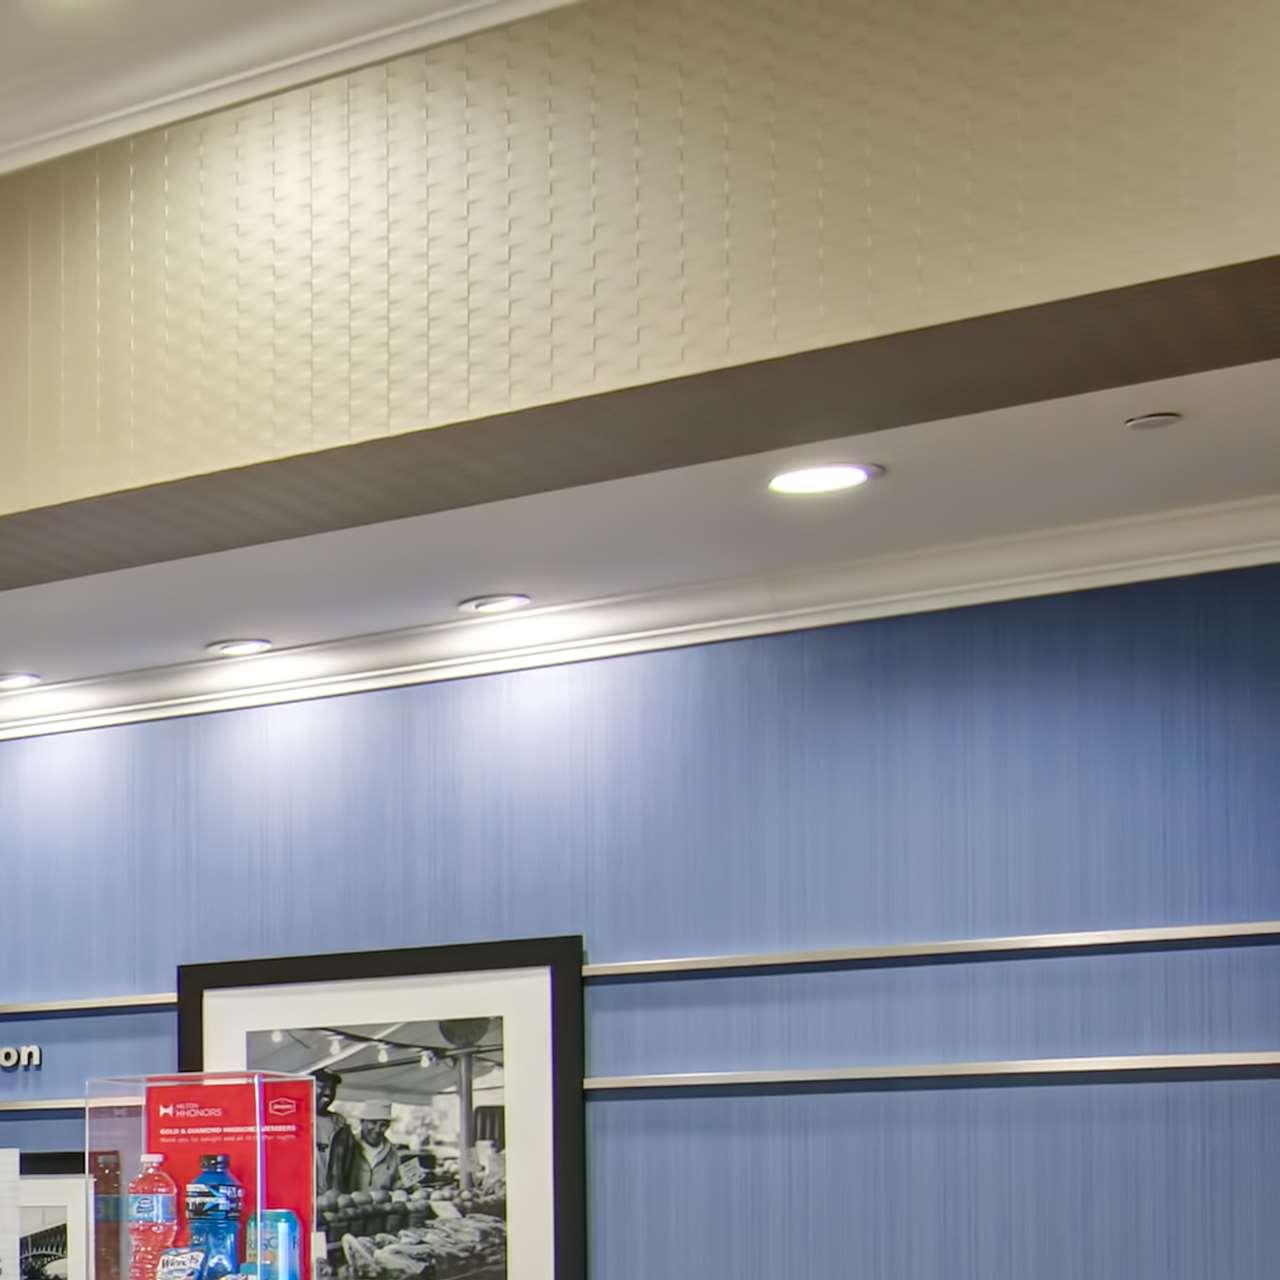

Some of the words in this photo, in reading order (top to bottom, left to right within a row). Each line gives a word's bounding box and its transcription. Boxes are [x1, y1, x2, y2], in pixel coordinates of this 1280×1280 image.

[175, 1108, 223, 1118] HHONORS
[159, 1127, 180, 1135] GOLD
[187, 1126, 222, 1135] DIAMOND
